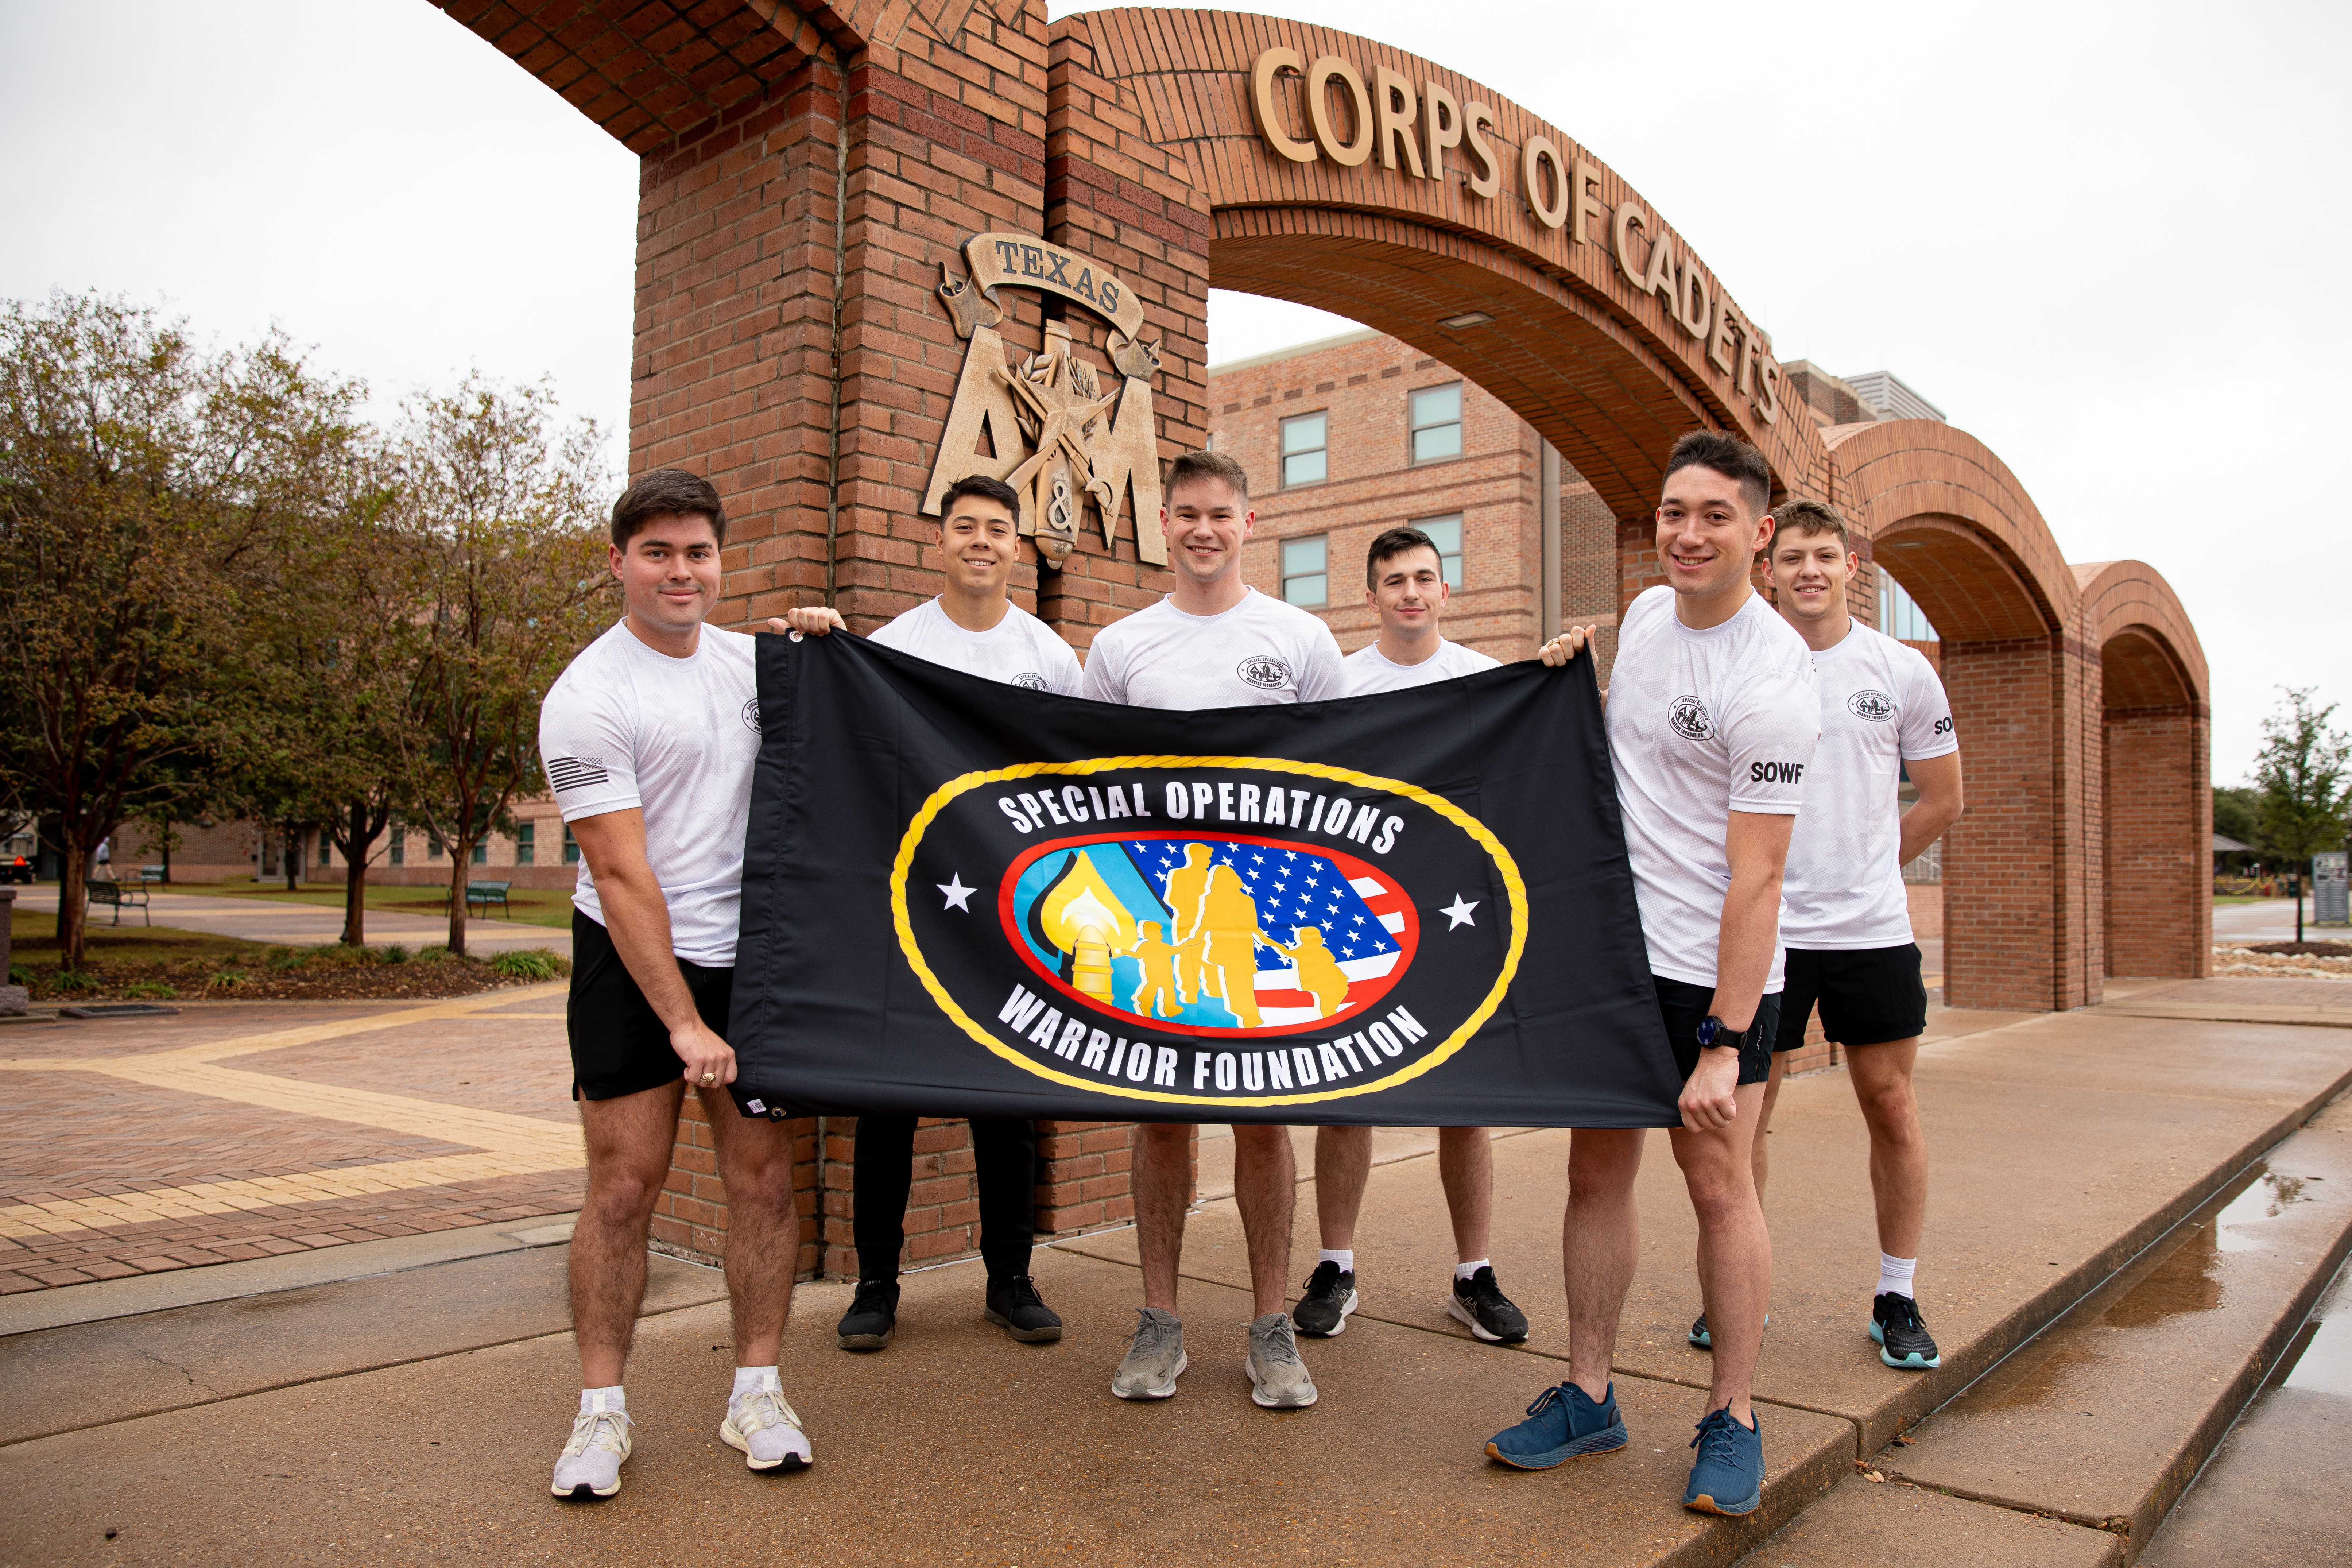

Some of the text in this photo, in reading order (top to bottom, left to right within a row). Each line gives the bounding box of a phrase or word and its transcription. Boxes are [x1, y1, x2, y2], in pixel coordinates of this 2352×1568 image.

[1251, 46, 1780, 426] CORPS OF CADETS
[995, 240, 1120, 314] TEXAS
[1262, 657, 1283, 668] OPERATIONS
[1246, 677, 1262, 686] WARRIOR
[747, 701, 758, 711] SPECIAL
[1871, 692, 1890, 702] OPERATIONS
[1856, 710, 1871, 719] WARRIOR
[1670, 716, 1704, 738] WARRIOR FOUNDATION
[1934, 717, 1953, 735] SO
[1751, 762, 1804, 784] SOWF
[998, 781, 1404, 855] SPECIAL OPERATIONS
[997, 983, 1429, 1092] WARRIOR FOUNDATION
